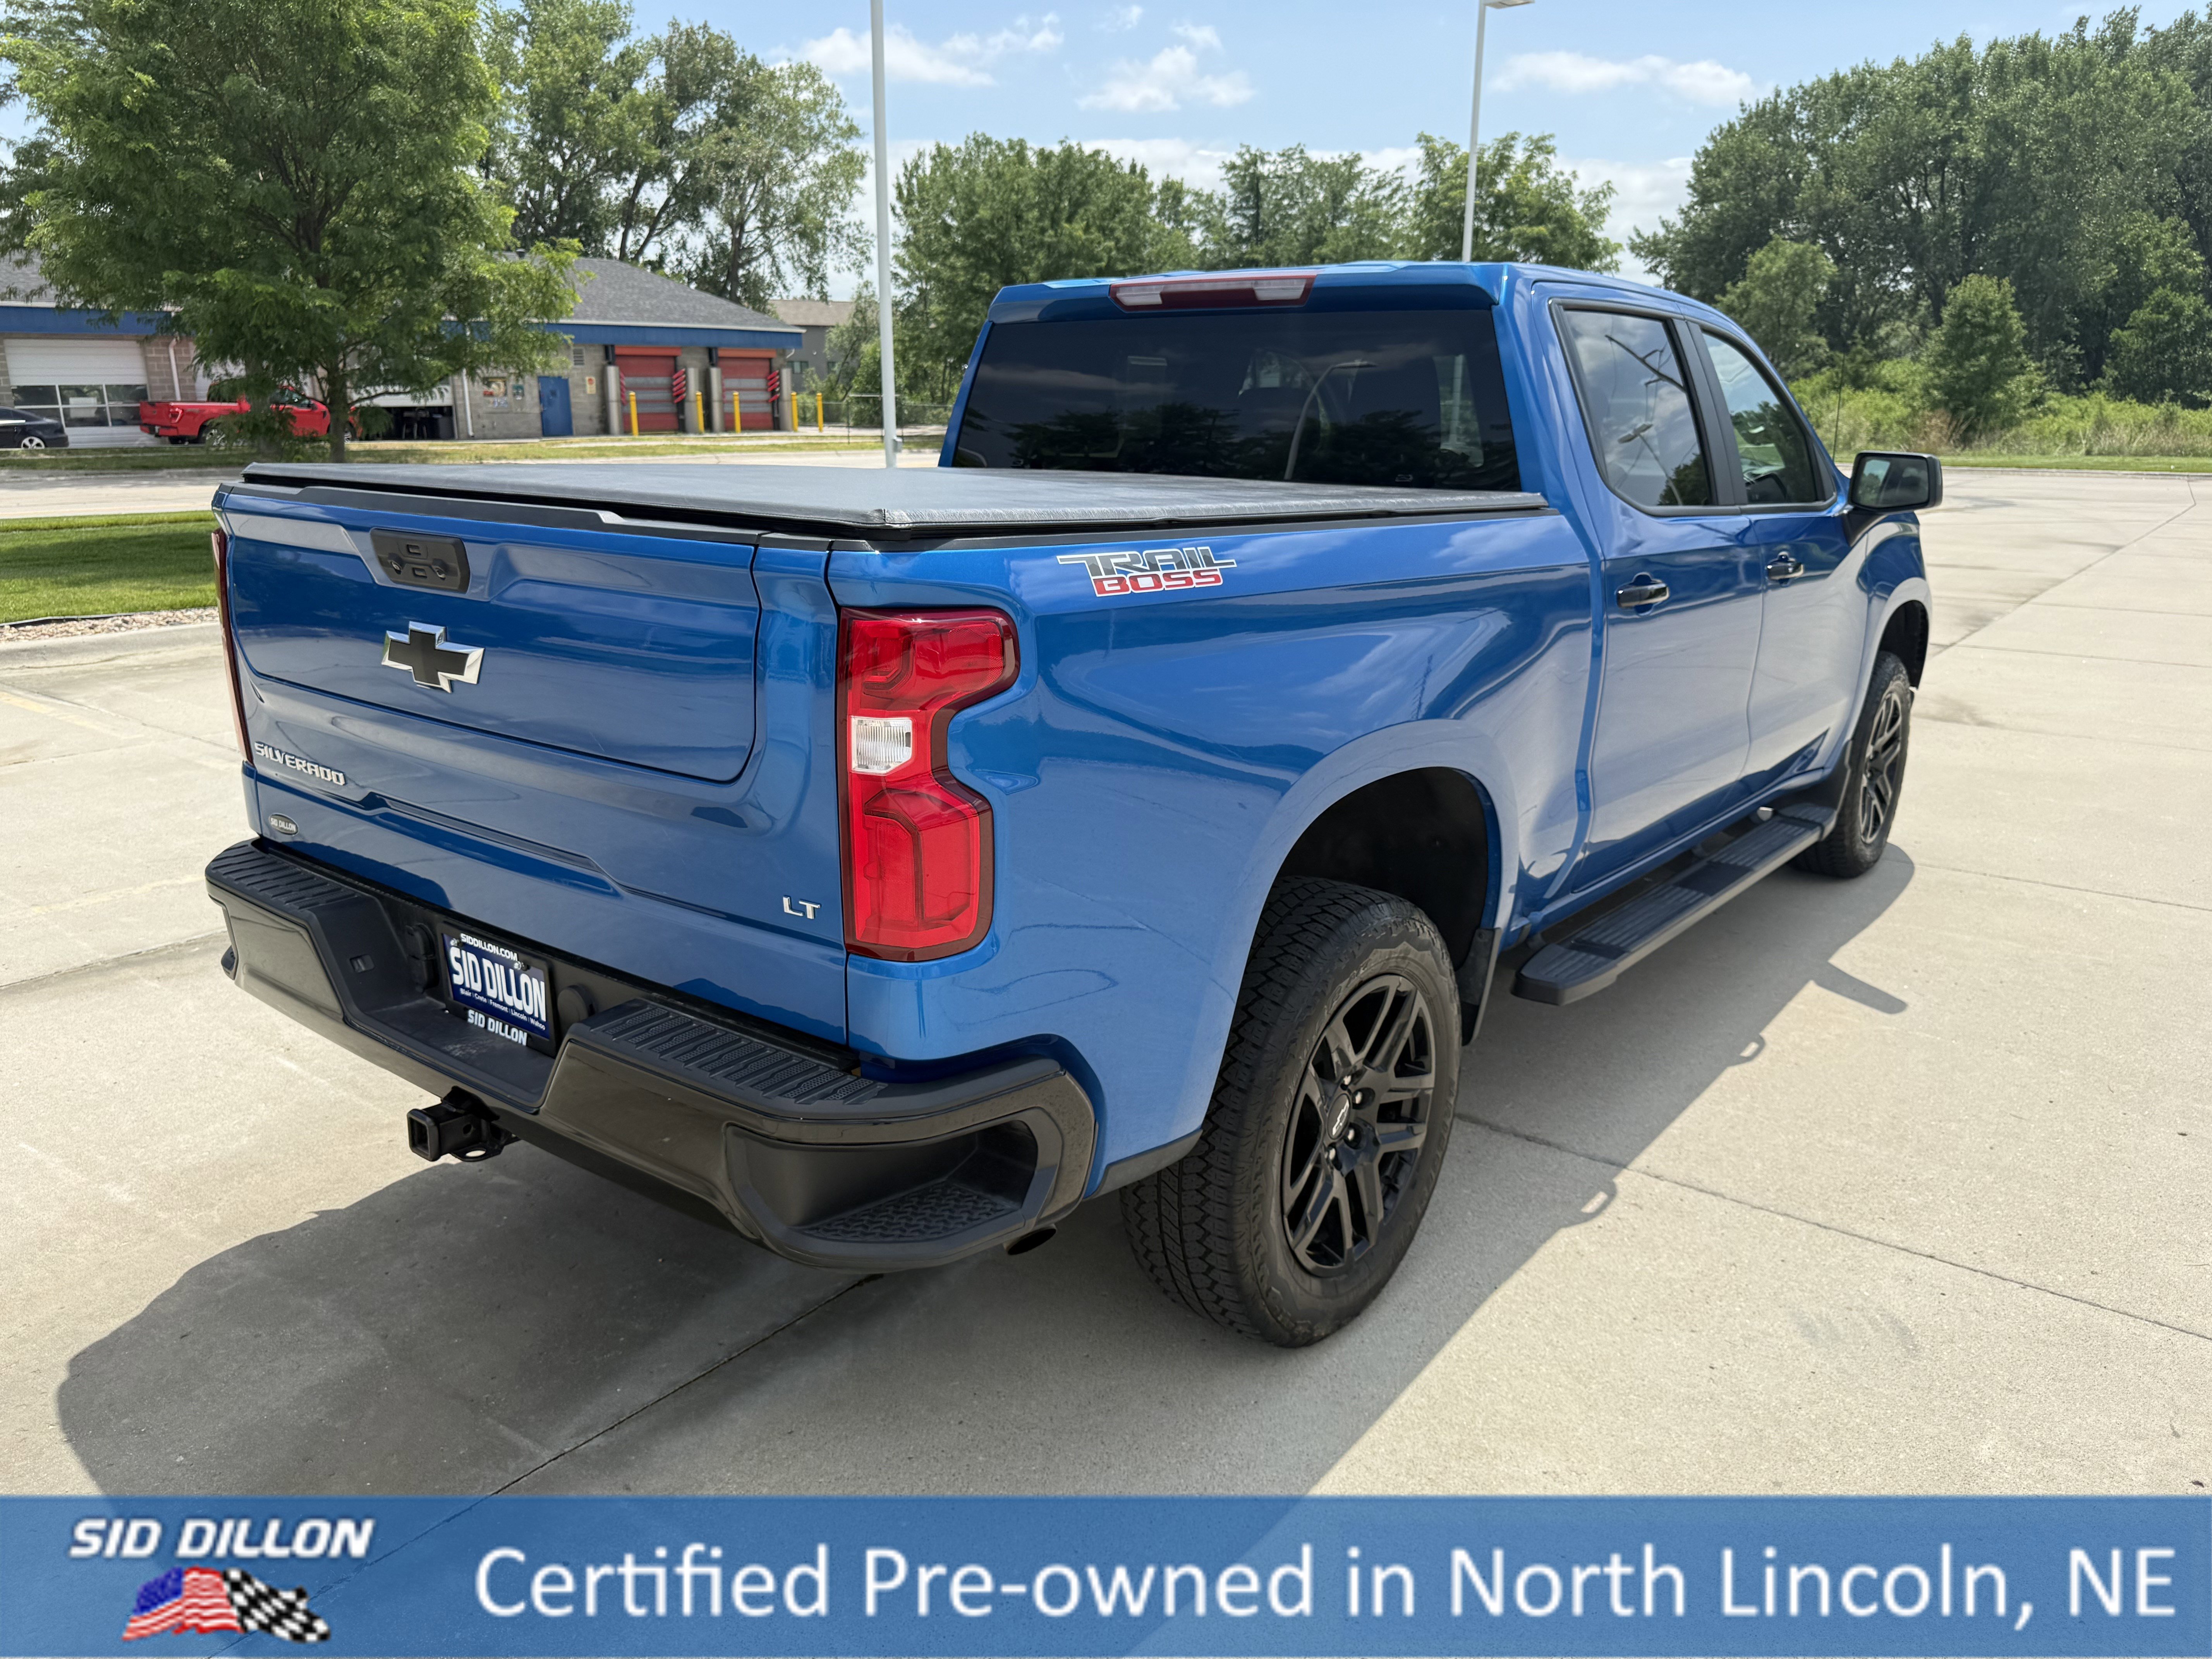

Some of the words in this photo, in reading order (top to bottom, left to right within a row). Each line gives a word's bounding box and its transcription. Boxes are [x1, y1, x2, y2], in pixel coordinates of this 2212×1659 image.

[1056, 546, 1237, 577] TRAIL
[1092, 568, 1223, 597] BOSS
[254, 741, 346, 786] SILVERADO
[279, 820, 296, 831] DILLON
[783, 895, 821, 919] LT
[460, 933, 518, 961] SIDDILLON.COM
[450, 946, 482, 993] SID
[482, 958, 546, 1022] DILLON
[460, 988, 472, 997] Blair
[474, 993, 488, 1003] Crete
[490, 999, 508, 1013] Fremont
[511, 1008, 528, 1021] Lincoln
[530, 1017, 546, 1031] Wahoo
[467, 1009, 486, 1028] SID
[488, 1017, 528, 1046] DILLON
